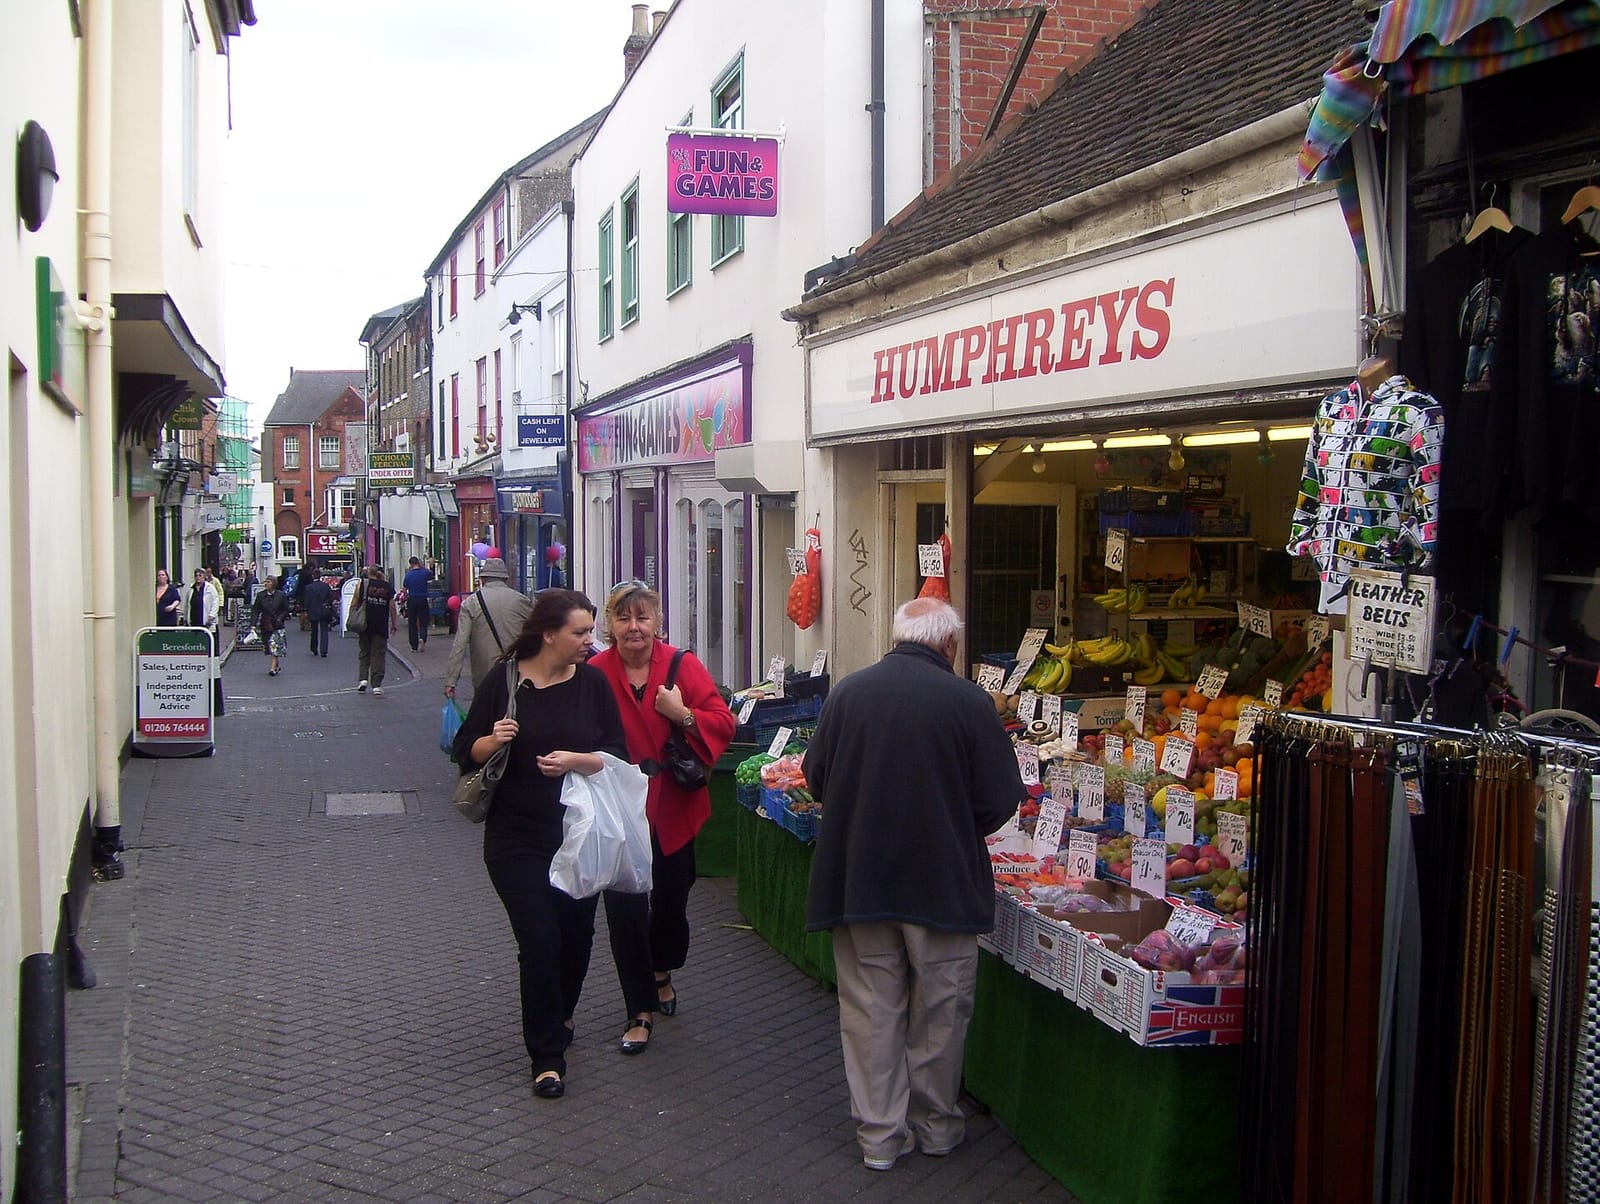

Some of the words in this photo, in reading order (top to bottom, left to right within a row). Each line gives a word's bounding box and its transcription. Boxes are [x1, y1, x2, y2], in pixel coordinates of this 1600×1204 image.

[676, 174, 774, 200] GAMES
[871, 277, 1175, 403] HUMPHREYS
[172, 413, 199, 423] Crown
[1352, 581, 1426, 608] LEATHER
[1362, 605, 1411, 627] BELTS
[1376, 630, 1395, 639] WIDE
[162, 643, 206, 651] Beresfords
[1376, 640, 1395, 649] WIDE
[142, 663, 168, 671] Sales,
[170, 663, 206, 672] Lettings
[146, 683, 203, 691] Independent
[153, 693, 196, 701] Mortgage
[145, 723, 171, 732] 01206
[173, 723, 205, 732] 764444
[993, 865, 1031, 873] Produce
[1177, 1011, 1235, 1027] ENGLISH
